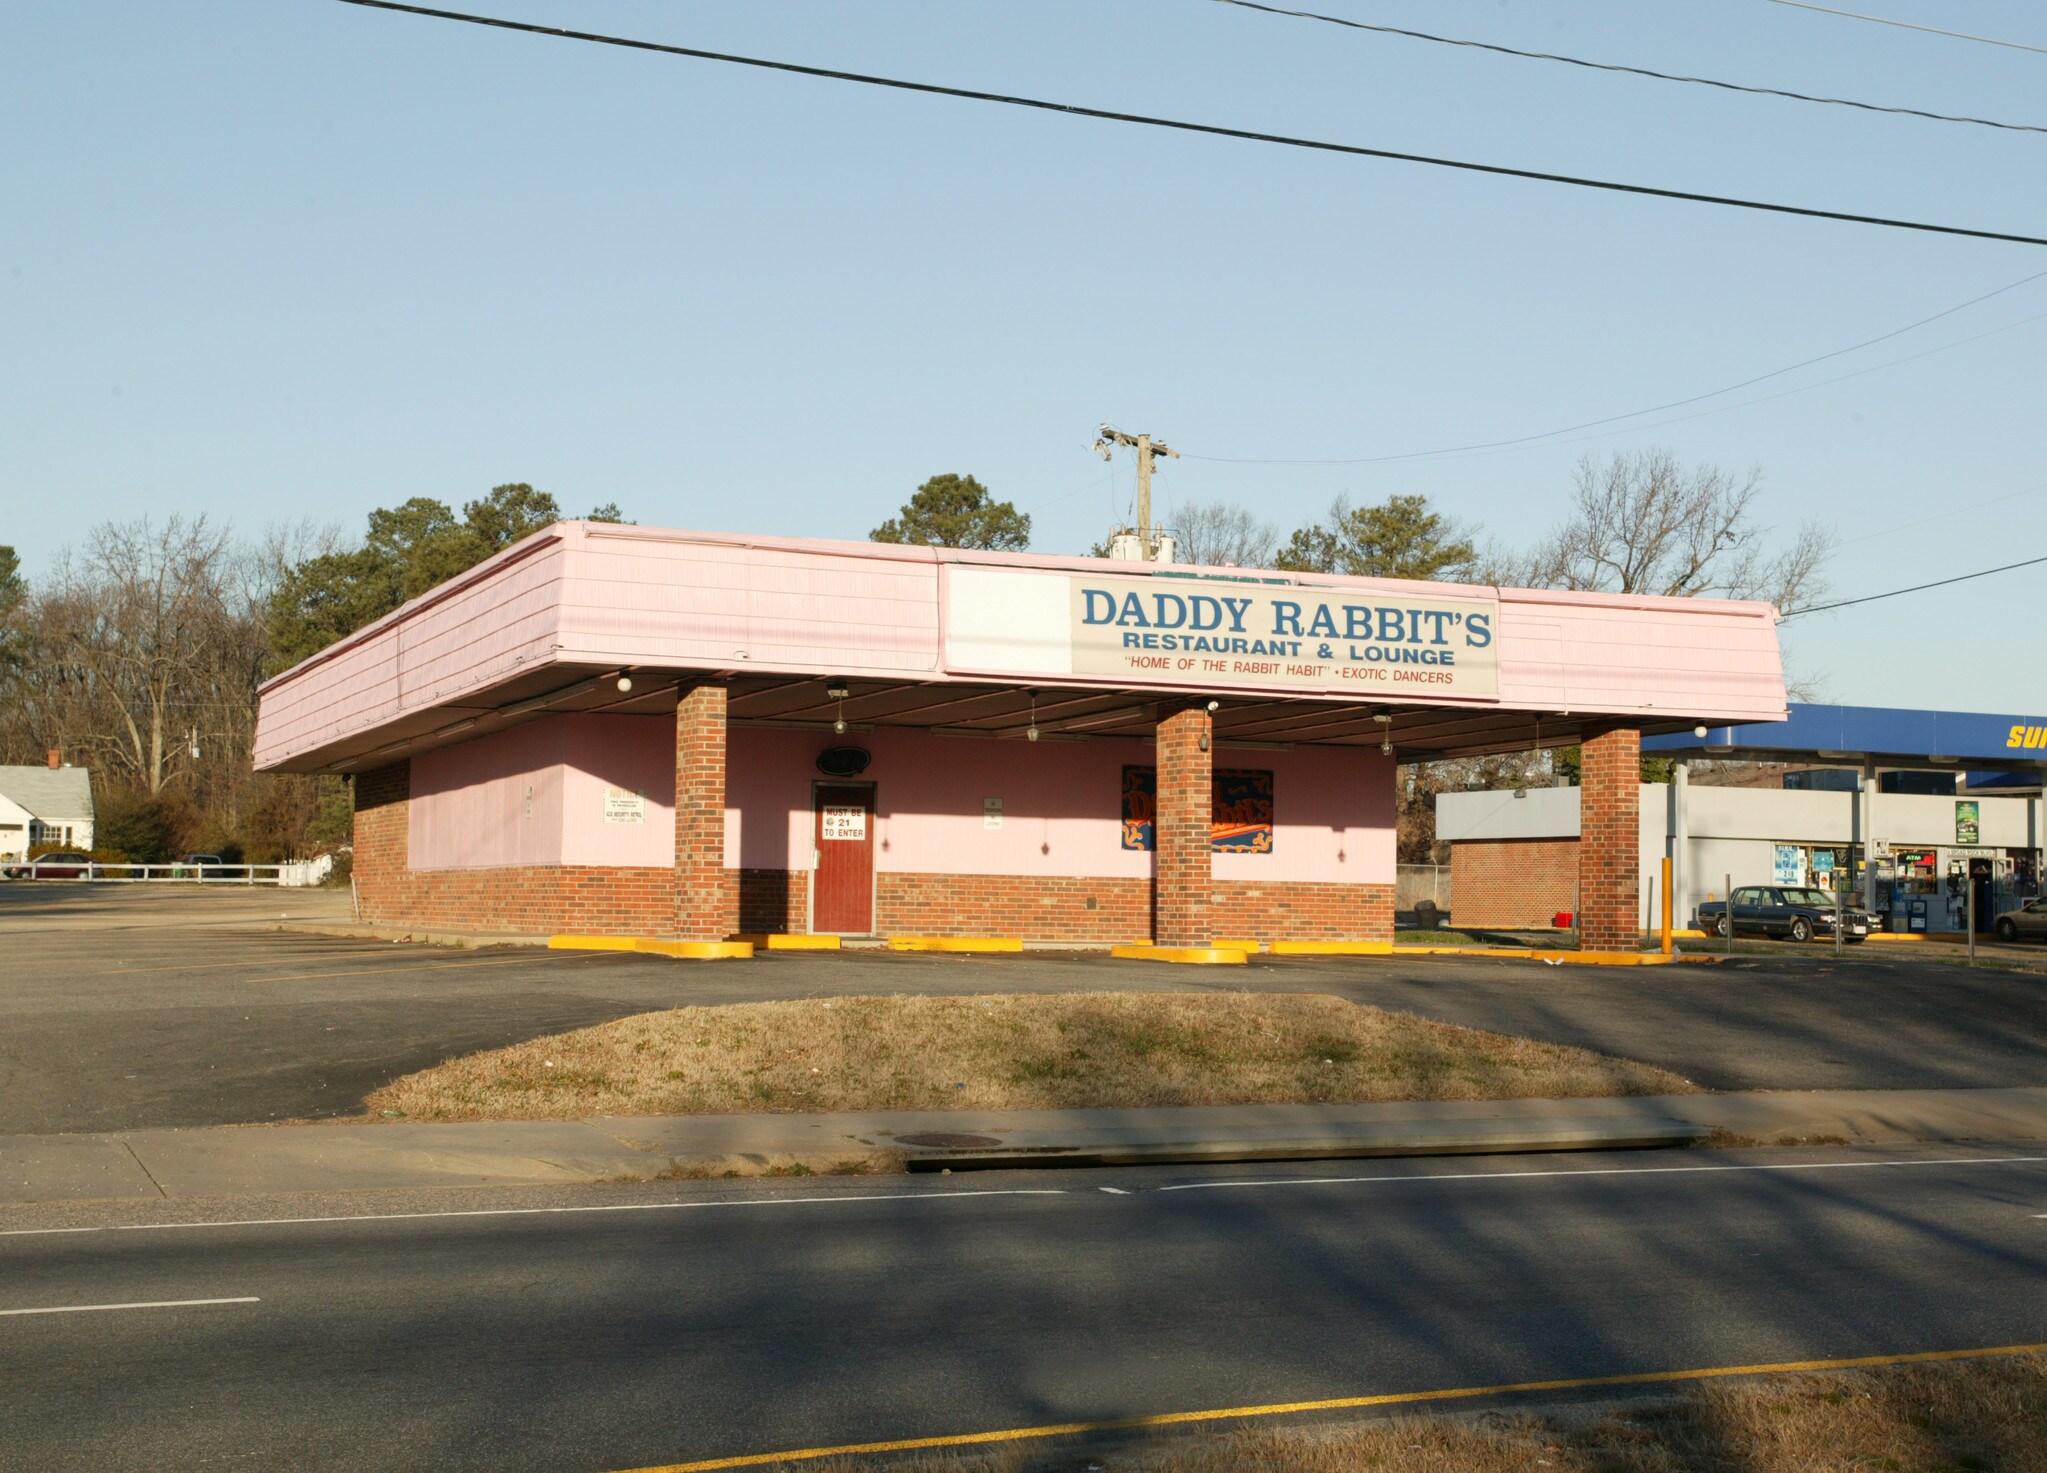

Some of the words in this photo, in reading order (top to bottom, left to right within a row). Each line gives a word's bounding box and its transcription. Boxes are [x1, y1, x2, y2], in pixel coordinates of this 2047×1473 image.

[1081, 588, 1253, 633] DADDY
[1271, 600, 1492, 648] RABBIT'S
[1123, 632, 1302, 657] RESTAURANT
[1317, 643, 1334, 659] &
[1350, 645, 1455, 666] LOUNGE
[1177, 658, 1196, 671] OF
[1202, 659, 1227, 672] THE
[1233, 661, 1280, 675] RABBIT
[1342, 667, 1388, 681] EXOTIC
[1393, 670, 1454, 684] DANCERS
[826, 808, 848, 817] MUST
[851, 808, 862, 817] BE
[838, 818, 850, 827] 21
[825, 828, 834, 837] TO
[838, 828, 864, 837] ENTER
